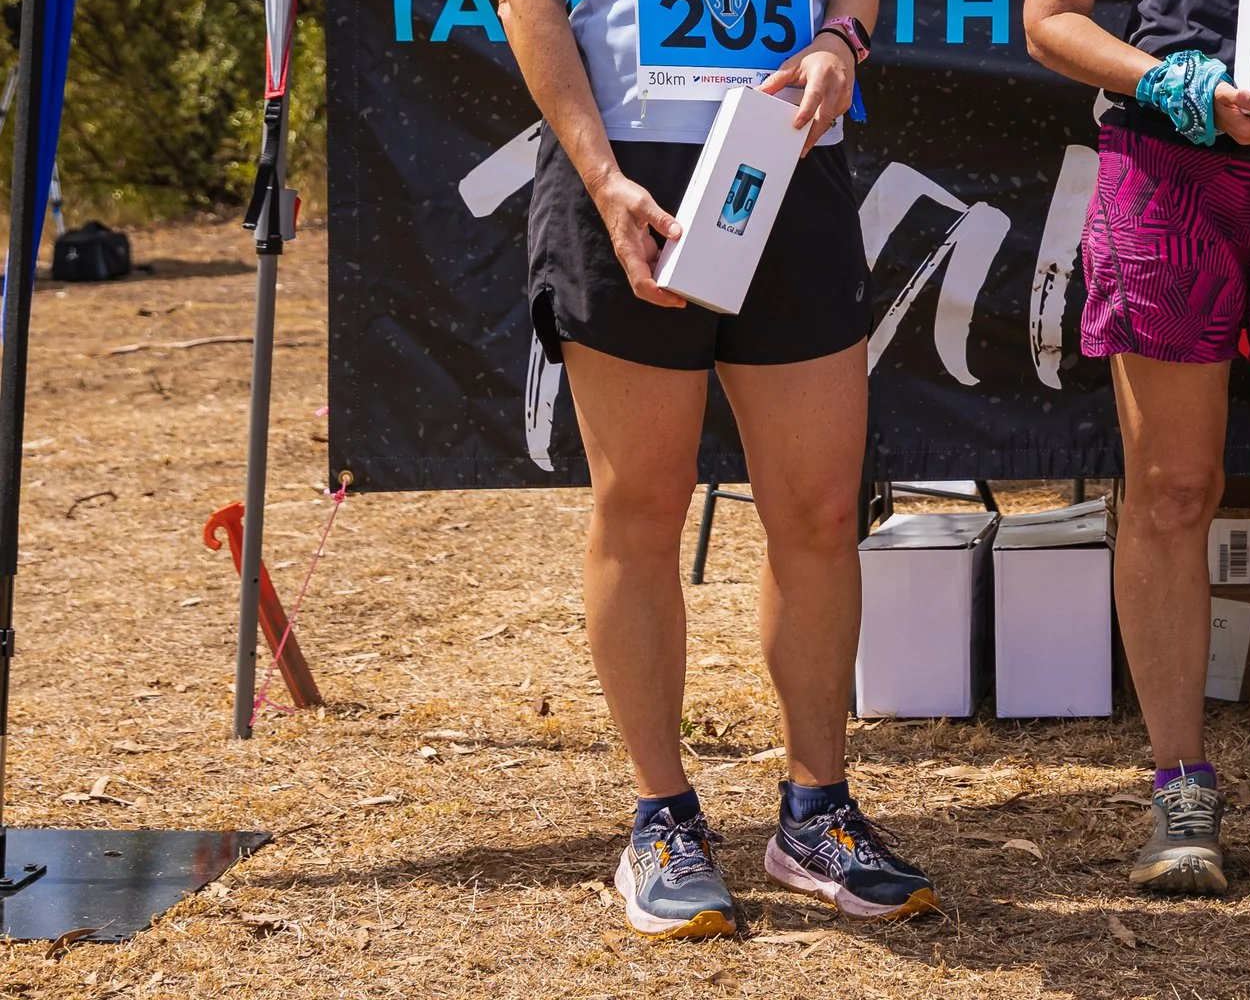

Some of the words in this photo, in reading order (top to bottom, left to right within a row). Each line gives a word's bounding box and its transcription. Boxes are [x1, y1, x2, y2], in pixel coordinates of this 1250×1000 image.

[648, 72, 686, 86] 30km
[701, 75, 753, 85] INTERSPORT
[1212, 618, 1228, 629] CC
